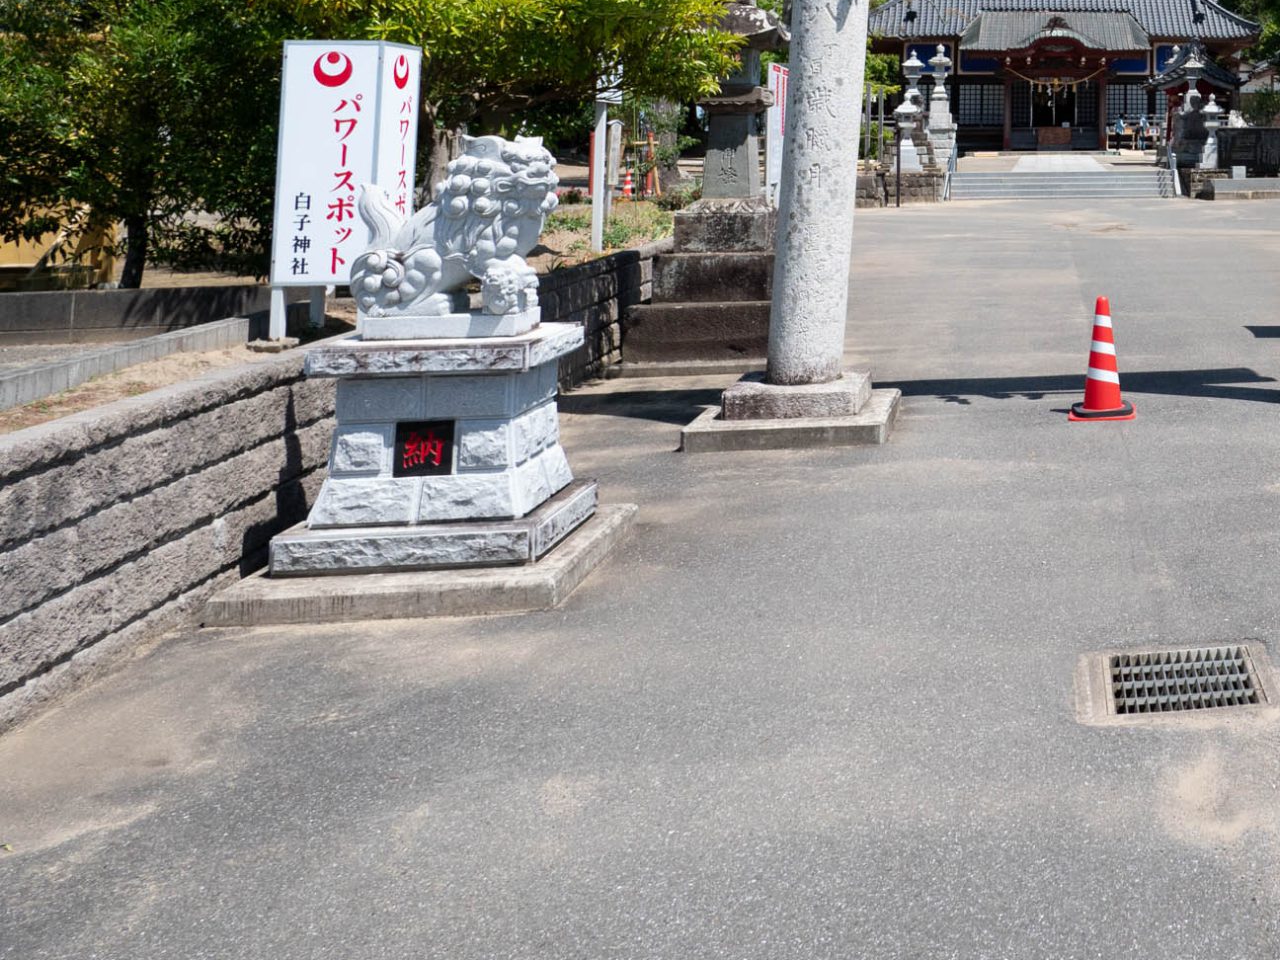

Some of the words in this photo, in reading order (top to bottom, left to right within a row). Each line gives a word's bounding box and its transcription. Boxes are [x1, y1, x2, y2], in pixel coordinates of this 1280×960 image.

[326, 94, 363, 275] パワースポット
[292, 191, 312, 276] 白子神社
[402, 430, 445, 470] 納
